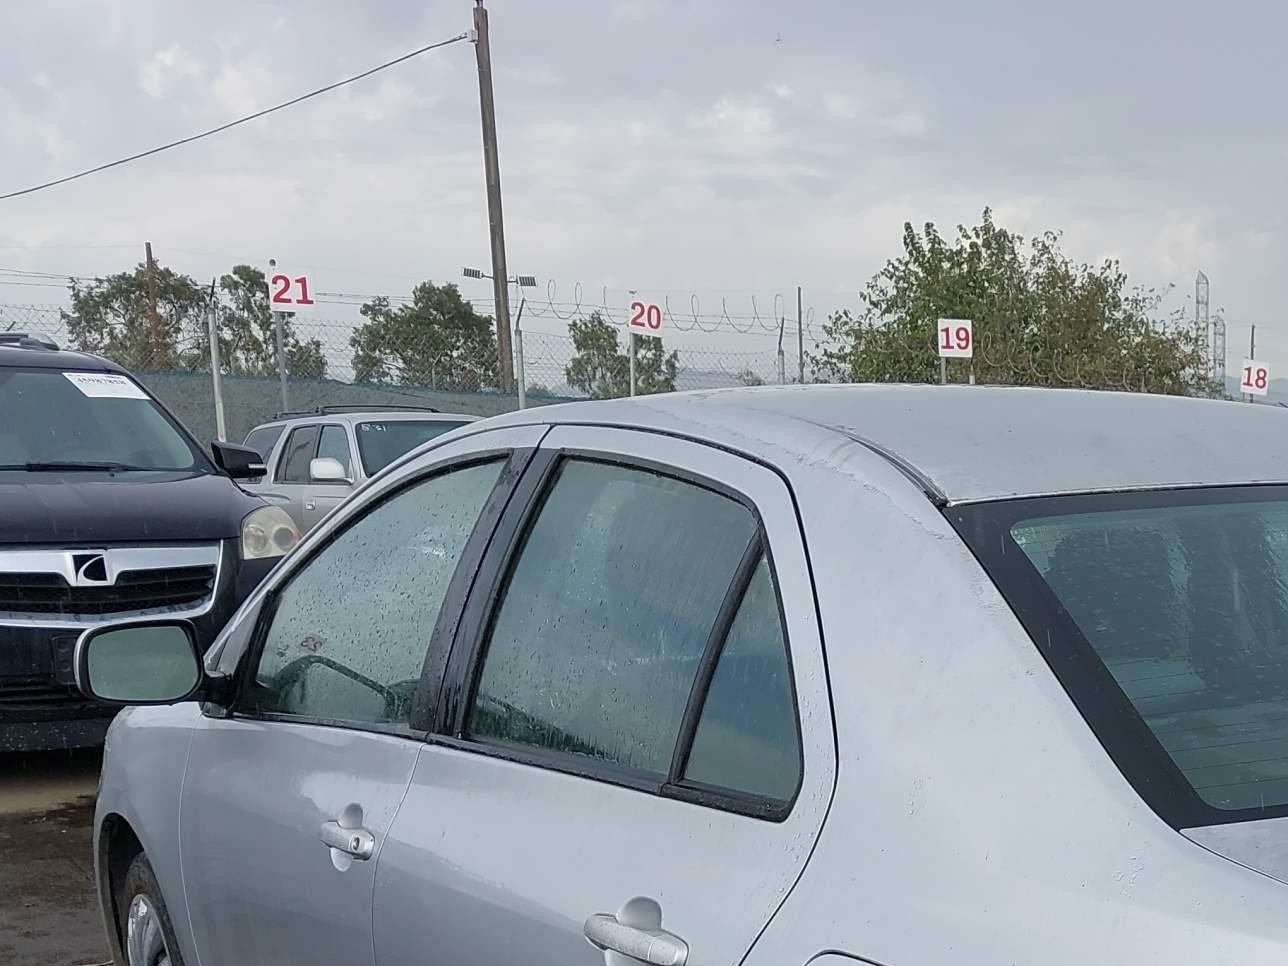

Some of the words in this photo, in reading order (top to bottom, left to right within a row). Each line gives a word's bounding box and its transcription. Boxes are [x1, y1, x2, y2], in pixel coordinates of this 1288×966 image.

[271, 274, 314, 304] 21
[630, 301, 661, 329] 20
[940, 326, 970, 350] 19
[1242, 366, 1267, 389] 18
